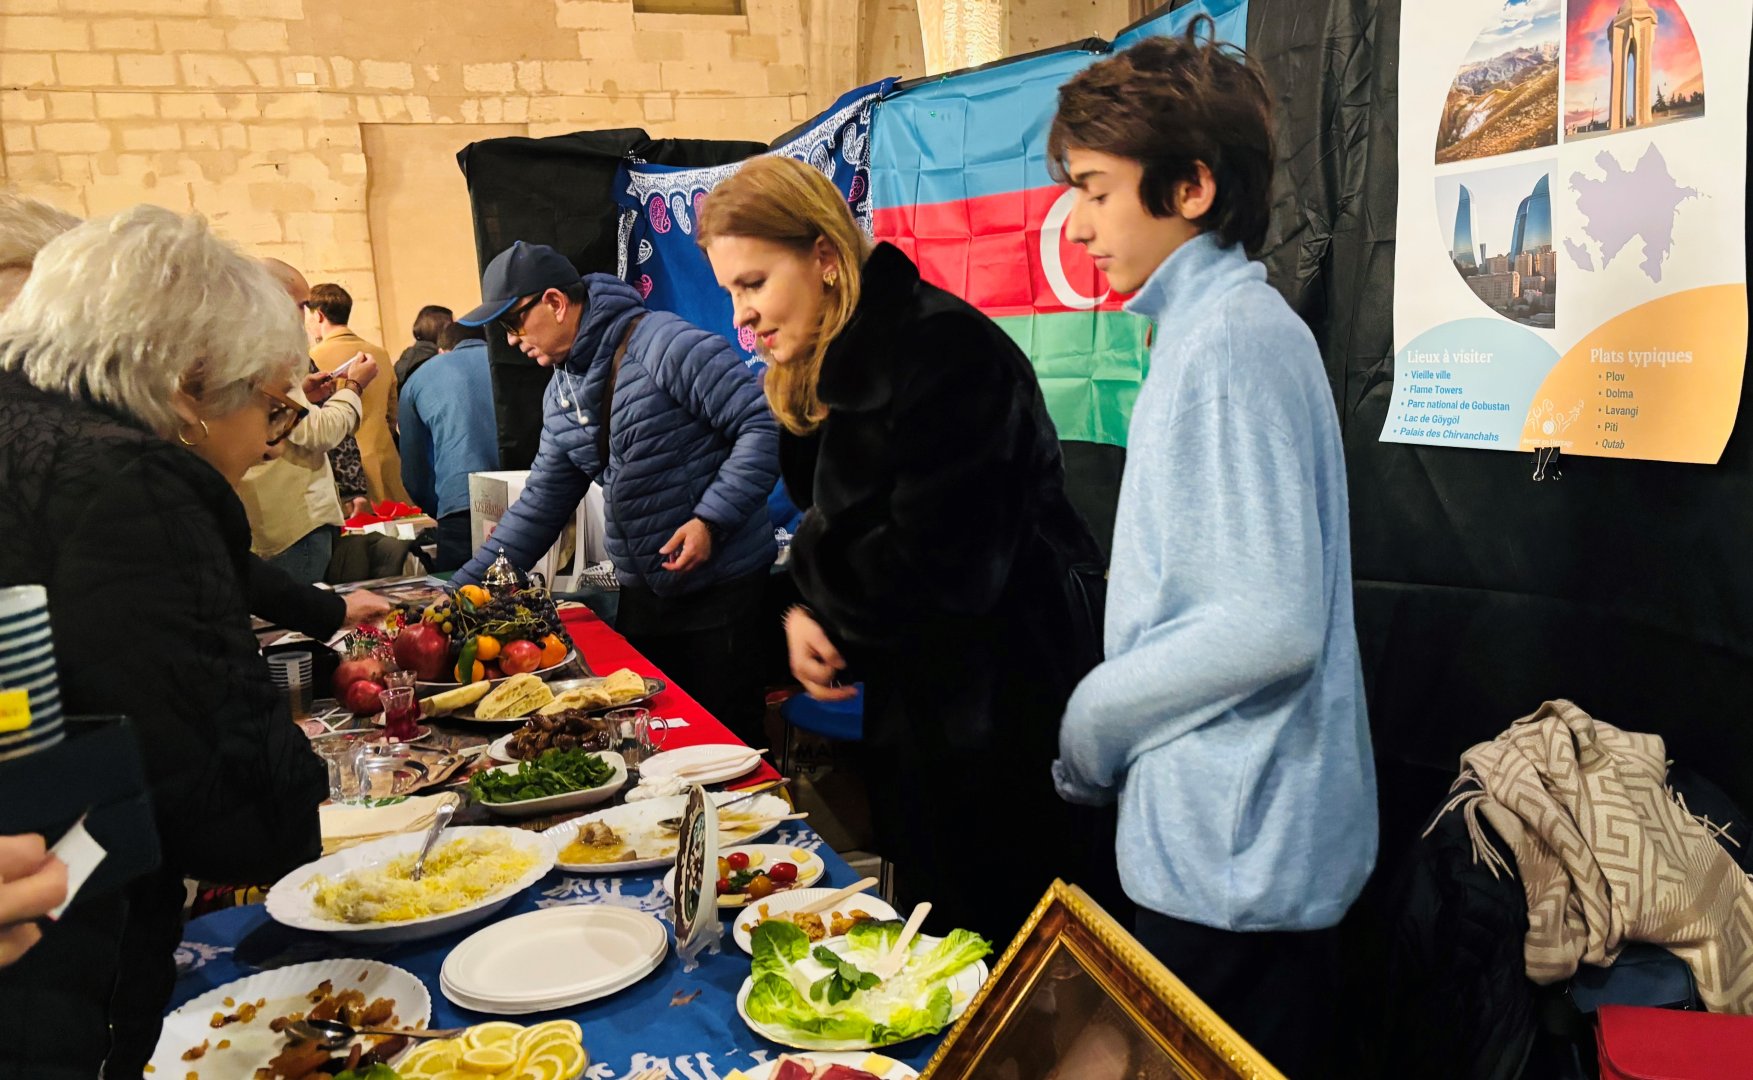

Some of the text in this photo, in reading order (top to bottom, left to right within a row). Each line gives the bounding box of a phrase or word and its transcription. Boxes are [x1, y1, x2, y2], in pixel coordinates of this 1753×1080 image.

[1407, 348, 1494, 364] Lieux à visiter
[1590, 346, 1693, 368] Plats typiques
[1411, 370, 1451, 380] Vieille ville
[1606, 371, 1625, 382] Plov
[1409, 385, 1463, 395] Flame Towers
[1606, 388, 1634, 399] Dolma
[1407, 399, 1510, 411] Parc national de Gobustan
[1605, 405, 1639, 418] Lavangi
[1404, 413, 1460, 426] Lac de Göygöl
[1604, 422, 1618, 432] Piti
[1399, 427, 1500, 442] Palais des Chirvanchahs
[1602, 438, 1625, 449] Qutab
